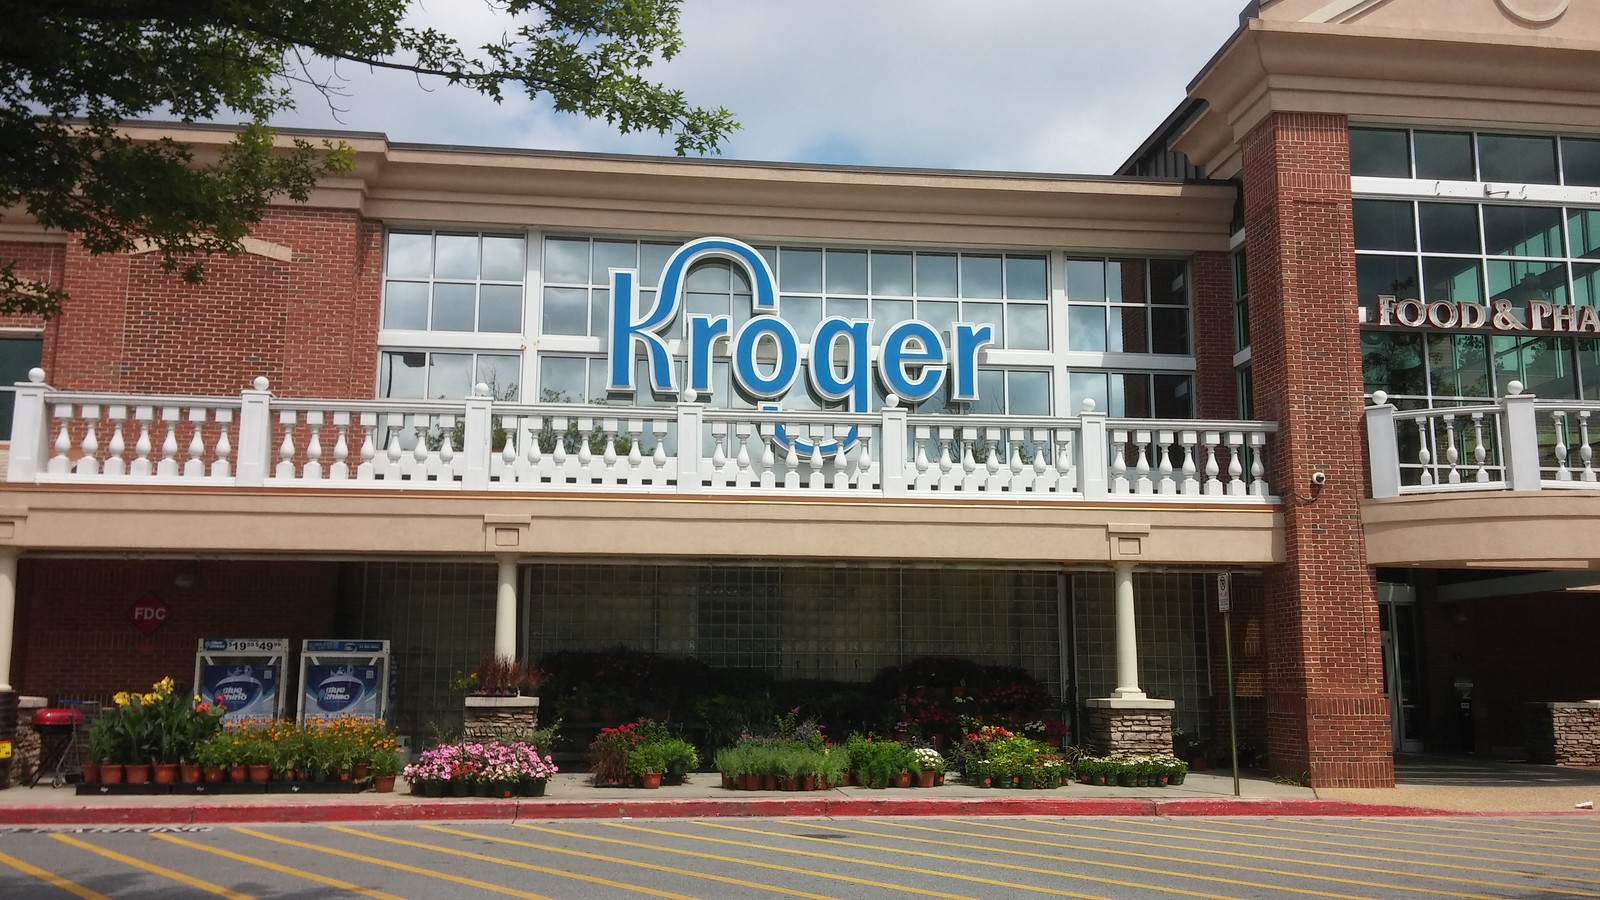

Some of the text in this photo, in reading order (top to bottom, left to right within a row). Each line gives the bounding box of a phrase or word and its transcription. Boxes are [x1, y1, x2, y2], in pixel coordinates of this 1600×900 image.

[1377, 295, 1485, 329] FOOD
[1493, 298, 1529, 330] &
[606, 236, 995, 458] Kroger
[134, 607, 166, 620] FDC
